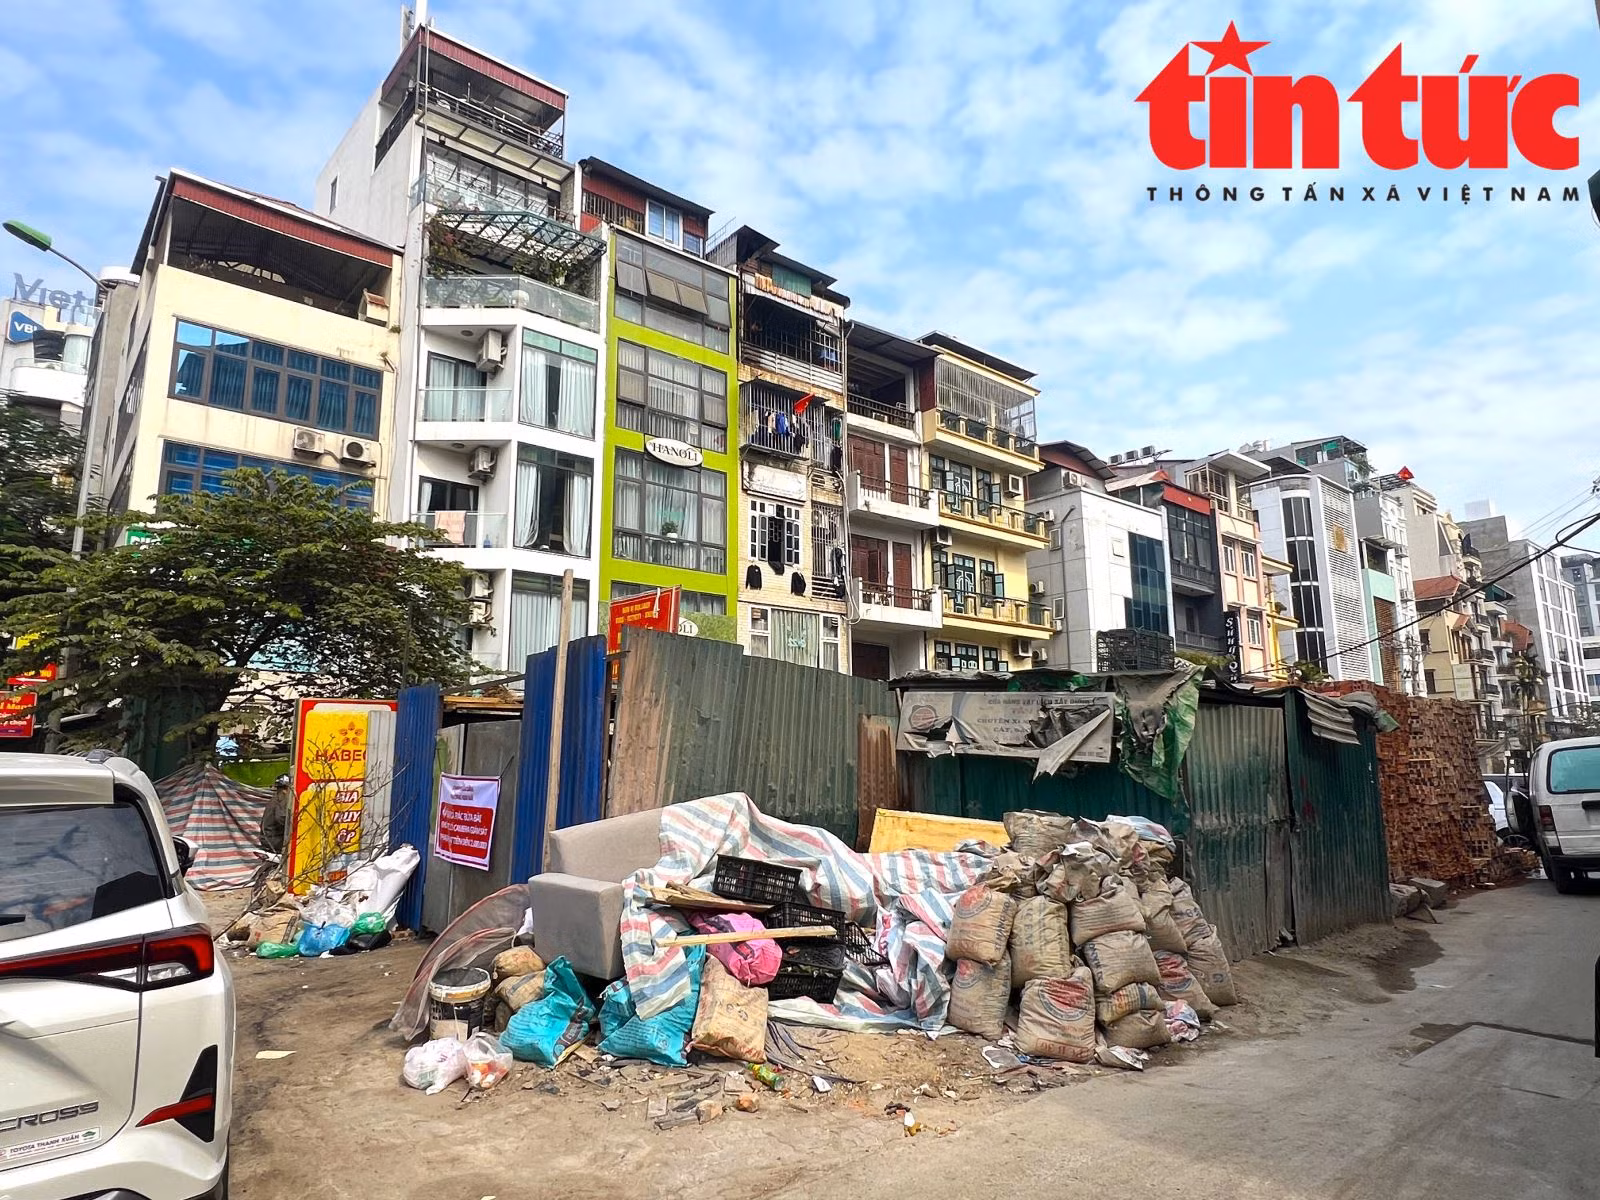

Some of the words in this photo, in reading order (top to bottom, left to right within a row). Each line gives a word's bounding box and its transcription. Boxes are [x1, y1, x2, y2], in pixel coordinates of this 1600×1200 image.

[652, 442, 698, 462] HANOLI
[0, 1101, 99, 1134] CROSS
[10, 1144, 35, 1154] TOYOTA
[37, 1139, 60, 1148] THANH
[61, 1134, 80, 1143] XUÂN
